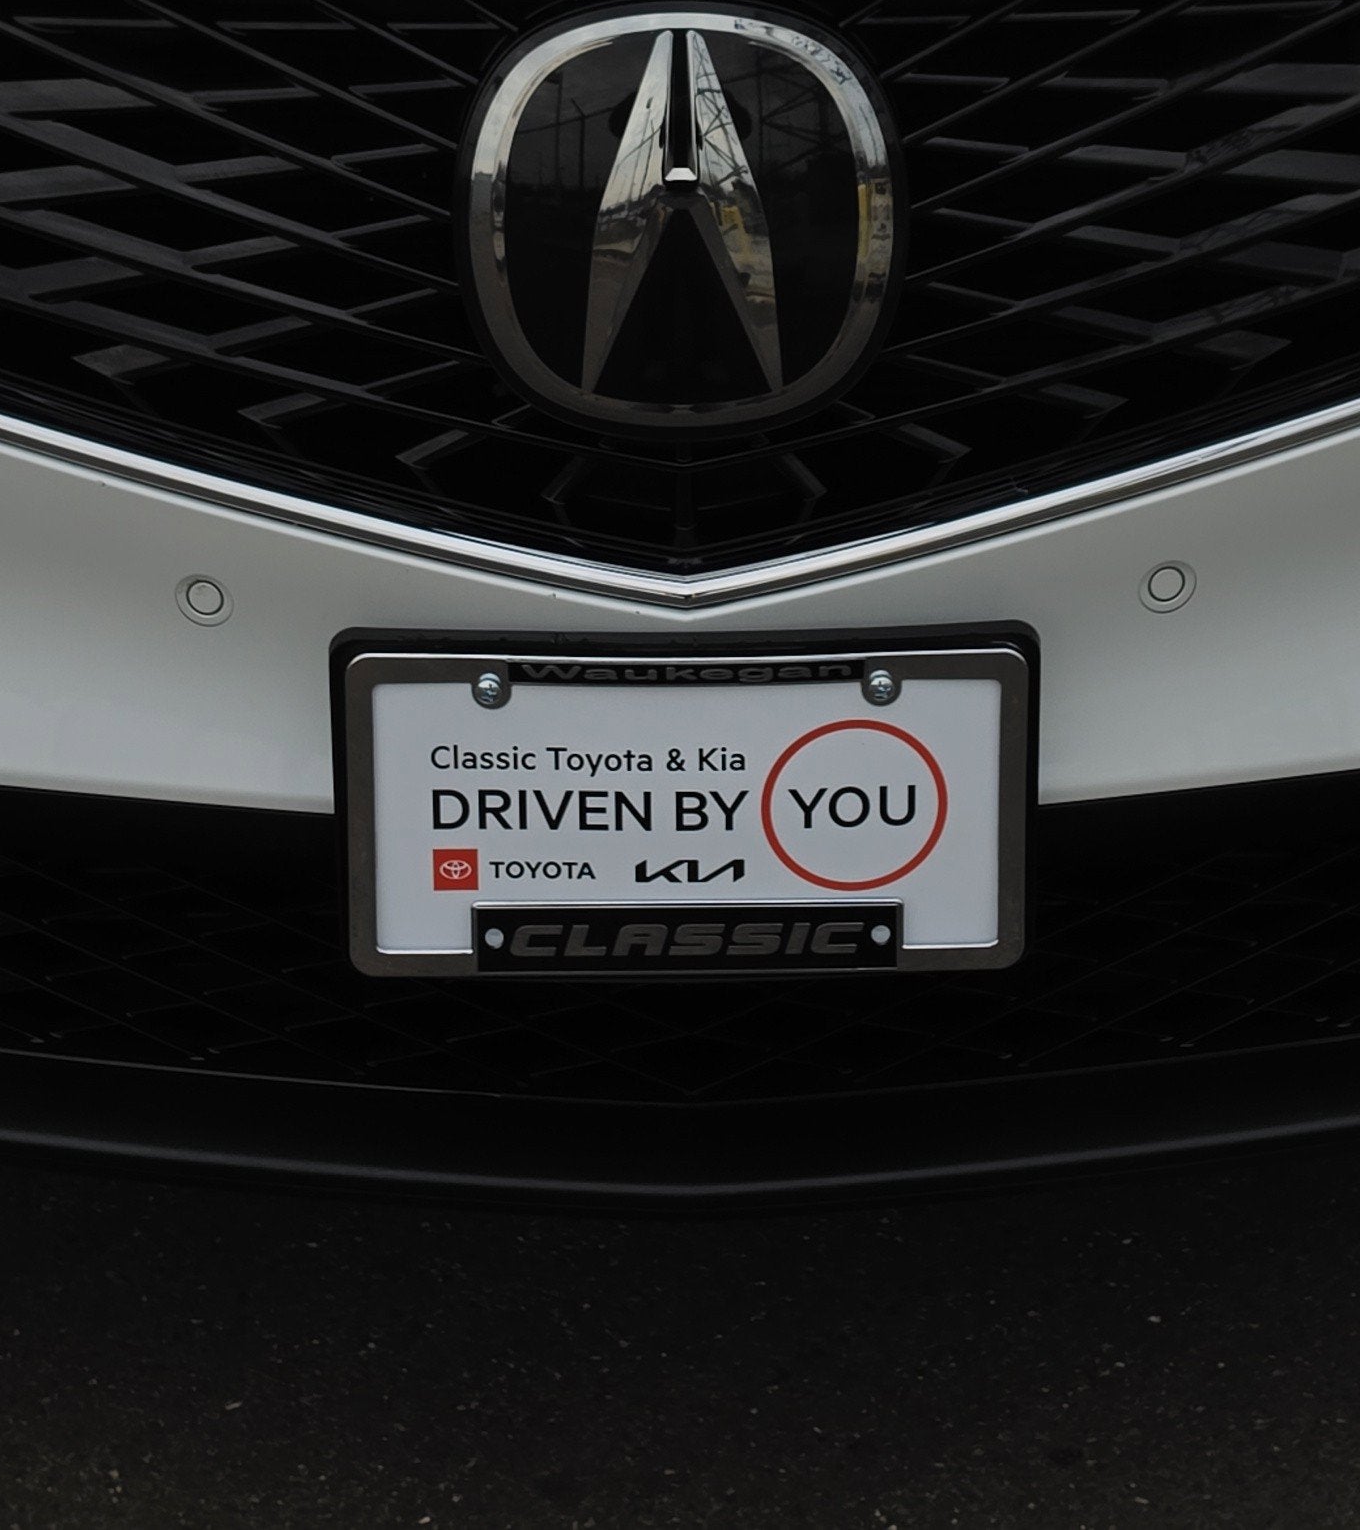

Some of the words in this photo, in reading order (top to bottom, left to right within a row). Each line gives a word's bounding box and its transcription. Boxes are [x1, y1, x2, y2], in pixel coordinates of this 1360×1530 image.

[520, 661, 853, 683] Waukegan
[430, 744, 536, 771] Classic
[546, 746, 654, 778] Toyota
[666, 747, 686, 772] &
[698, 746, 746, 772] Kia
[432, 788, 652, 831] DRIVEN
[674, 790, 750, 831] BY
[789, 784, 917, 828] YOU
[489, 860, 596, 880] TOYOTA
[508, 922, 865, 957] CLASSIC
